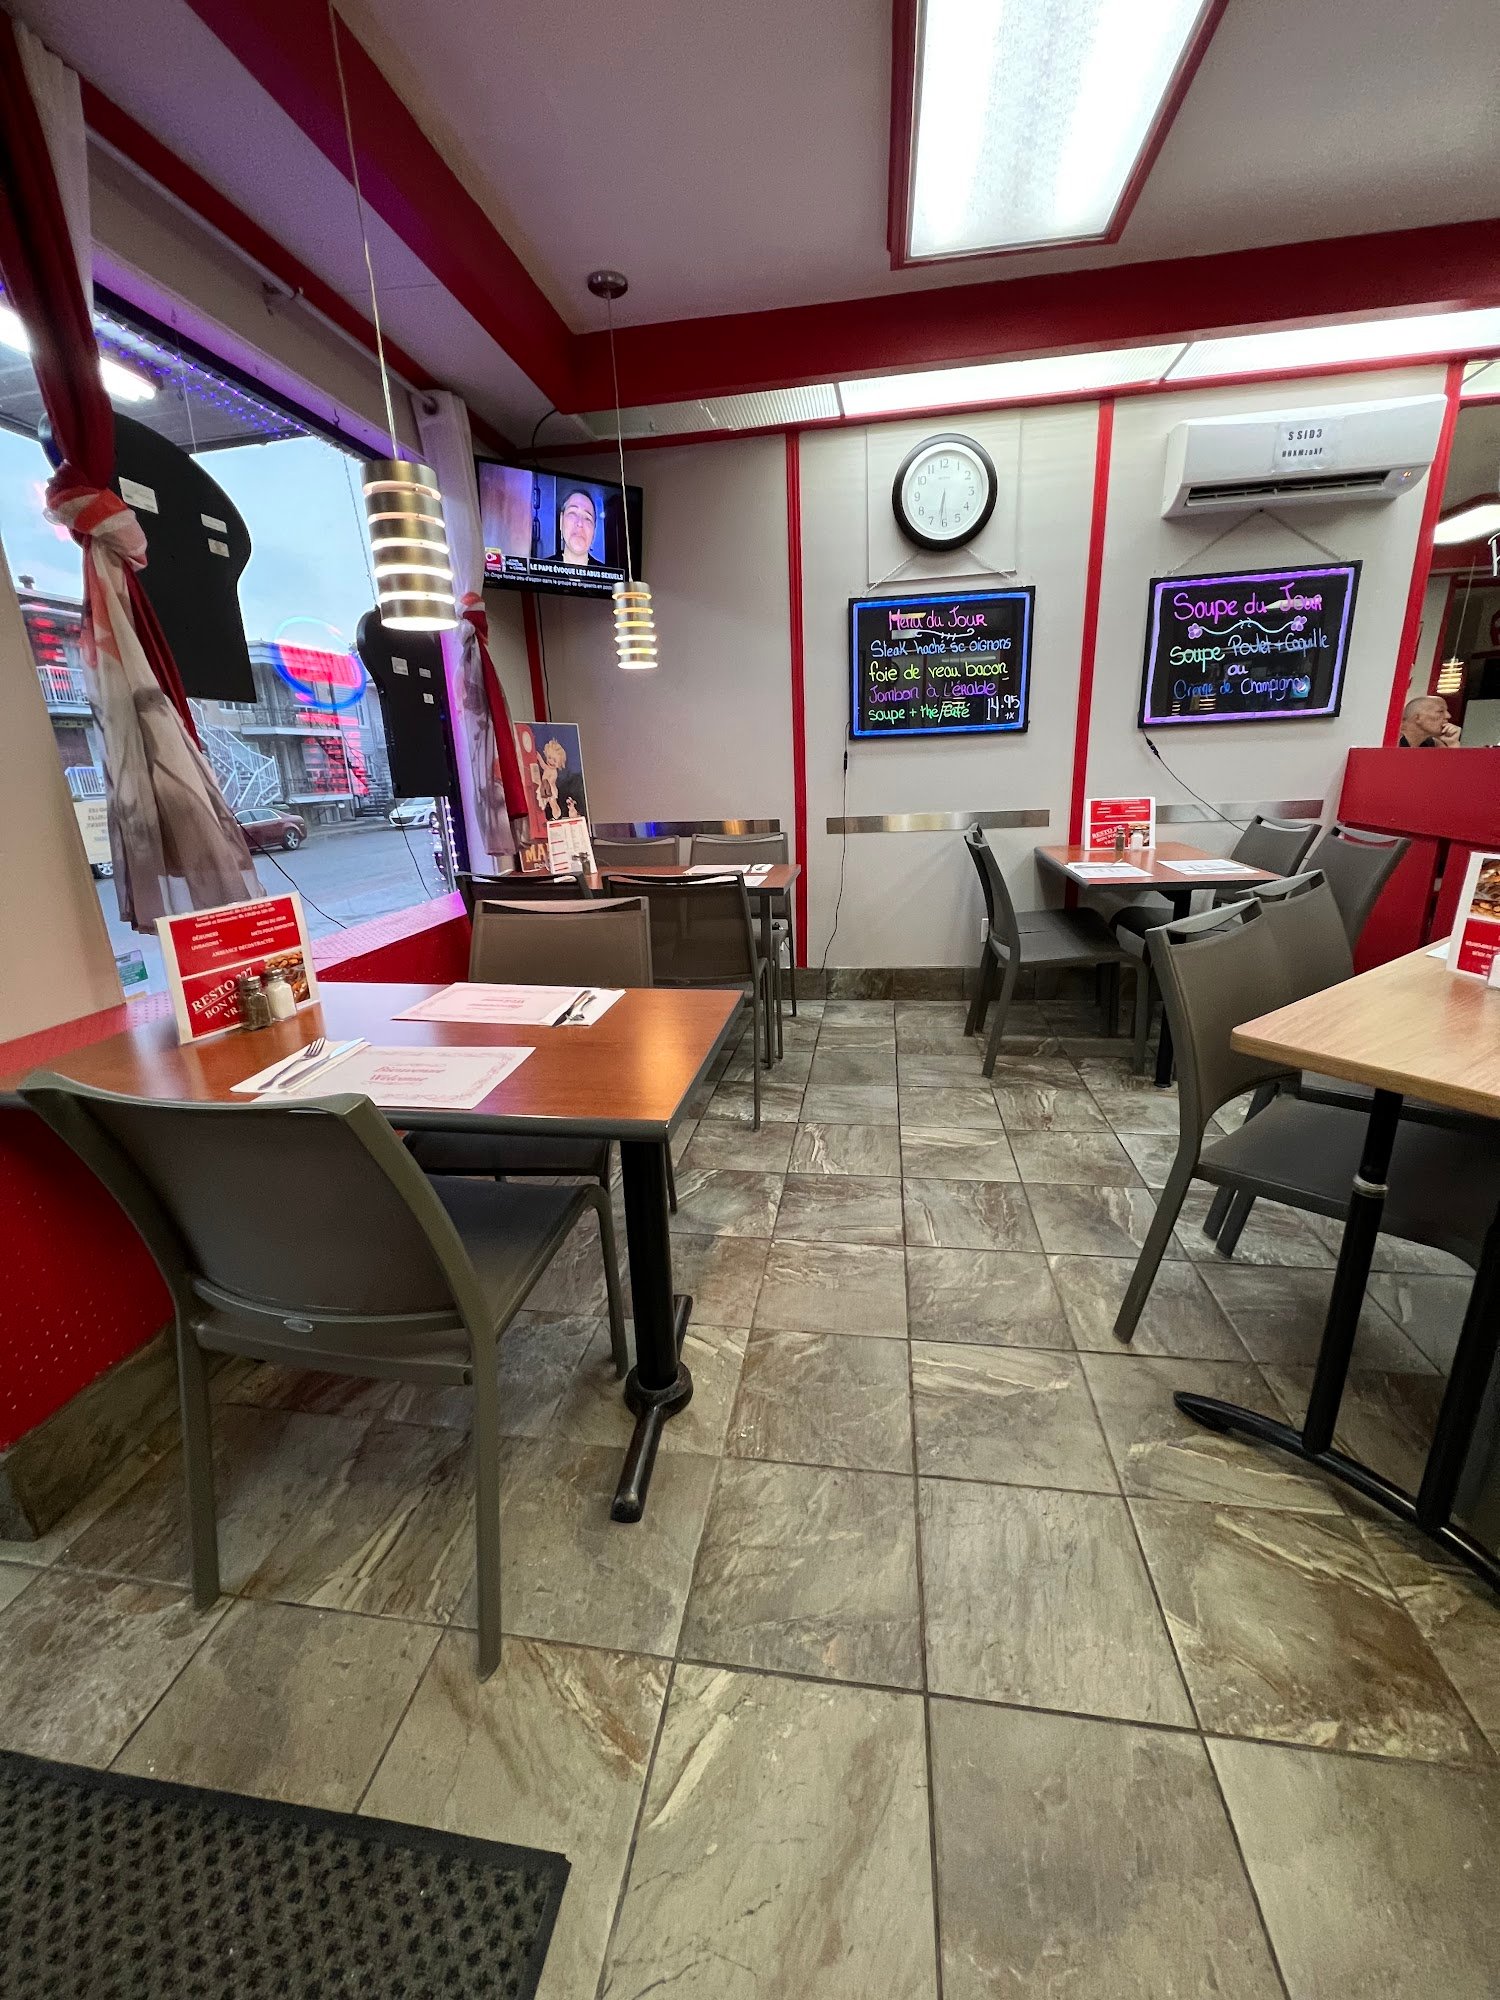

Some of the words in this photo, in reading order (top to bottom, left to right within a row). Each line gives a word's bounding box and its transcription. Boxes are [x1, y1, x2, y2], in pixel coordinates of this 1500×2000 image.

[928, 464, 935, 475] 11
[940, 458, 949, 469] 12
[957, 461, 960, 471] 1
[917, 475, 927, 486] 10
[964, 470, 971, 480] 2
[914, 491, 920, 501] 9
[968, 486, 975, 496] 3
[918, 506, 924, 516] 8
[963, 501, 969, 511] 4
[928, 516, 934, 526] 7
[941, 518, 948, 528] 6
[954, 513, 961, 523] 5
[530, 563, 537, 571] LE
[538, 564, 553, 573] PAPE
[553, 565, 576, 576] ÉVOQUE
[576, 569, 587, 577] LES
[601, 572, 624, 581] SEXUELS
[1173, 592, 1238, 624] Soupe
[1244, 592, 1268, 613] du
[1280, 582, 1323, 612] Jour
[889, 608, 923, 631] Menu
[927, 610, 944, 628] du
[948, 605, 987, 628] Jour
[870, 640, 908, 658] Steak
[914, 638, 946, 655] haché
[1169, 646, 1225, 672] Soupe
[1228, 633, 1271, 656] Poulet
[1285, 627, 1330, 657] Coquille
[869, 660, 898, 682] foie
[904, 664, 921, 680] de
[928, 666, 961, 678] veau
[965, 661, 1008, 677] bacon
[1228, 664, 1249, 676] ou
[1220, 678, 1233, 694] de
[869, 684, 919, 703] Jambon
[926, 684, 938, 697] à
[987, 694, 1021, 720] 14.95
[868, 706, 905, 724] soupe
[909, 709, 917, 718] +
[525, 843, 550, 863] MA
[191, 979, 235, 1012] RESTO
[204, 1000, 228, 1019] BON
[228, 991, 241, 1004] PO
[223, 1006, 240, 1018] VR
